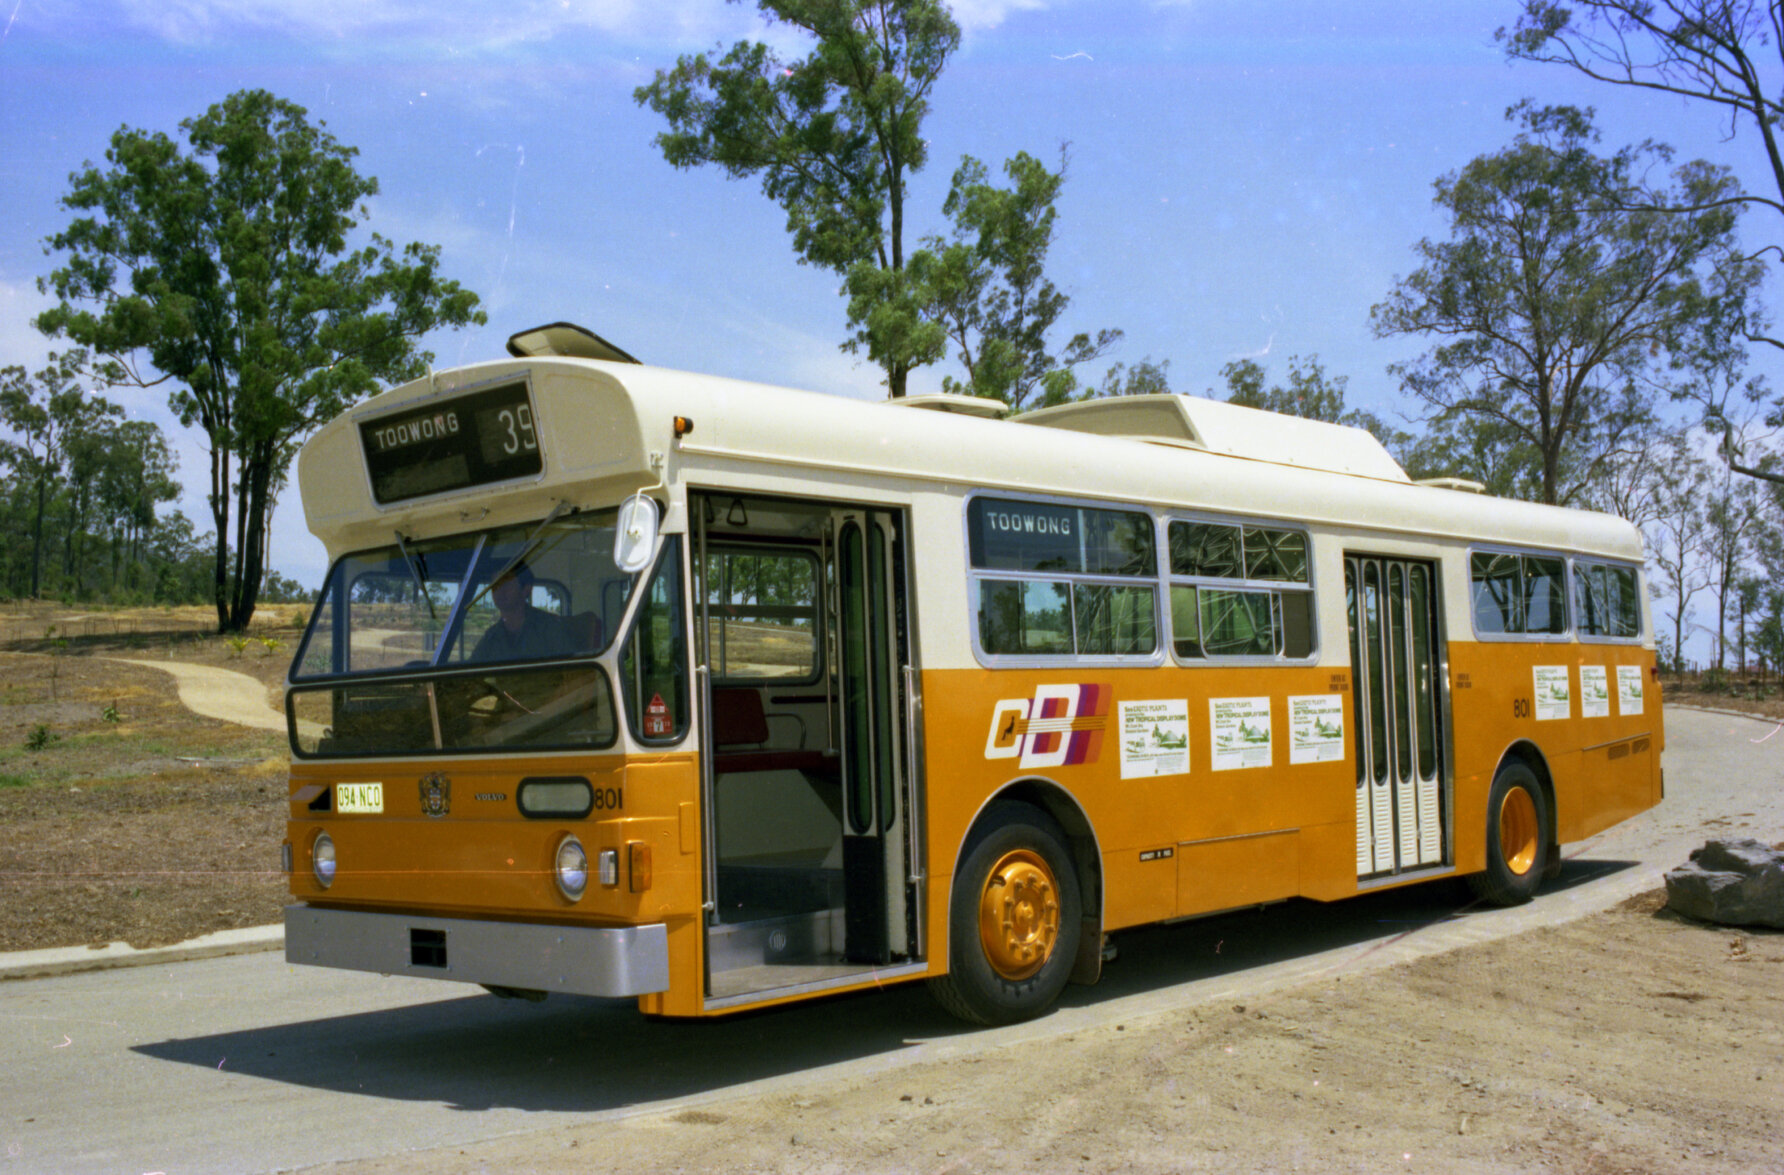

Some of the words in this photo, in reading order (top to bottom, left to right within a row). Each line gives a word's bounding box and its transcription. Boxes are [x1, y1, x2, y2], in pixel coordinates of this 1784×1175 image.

[375, 412, 460, 449] TOOWONG
[498, 403, 537, 454] 39
[987, 511, 1070, 535] TOOWONG
[1513, 698, 1530, 718] 801
[475, 793, 505, 801] VOLVO
[594, 787, 623, 810] 801
